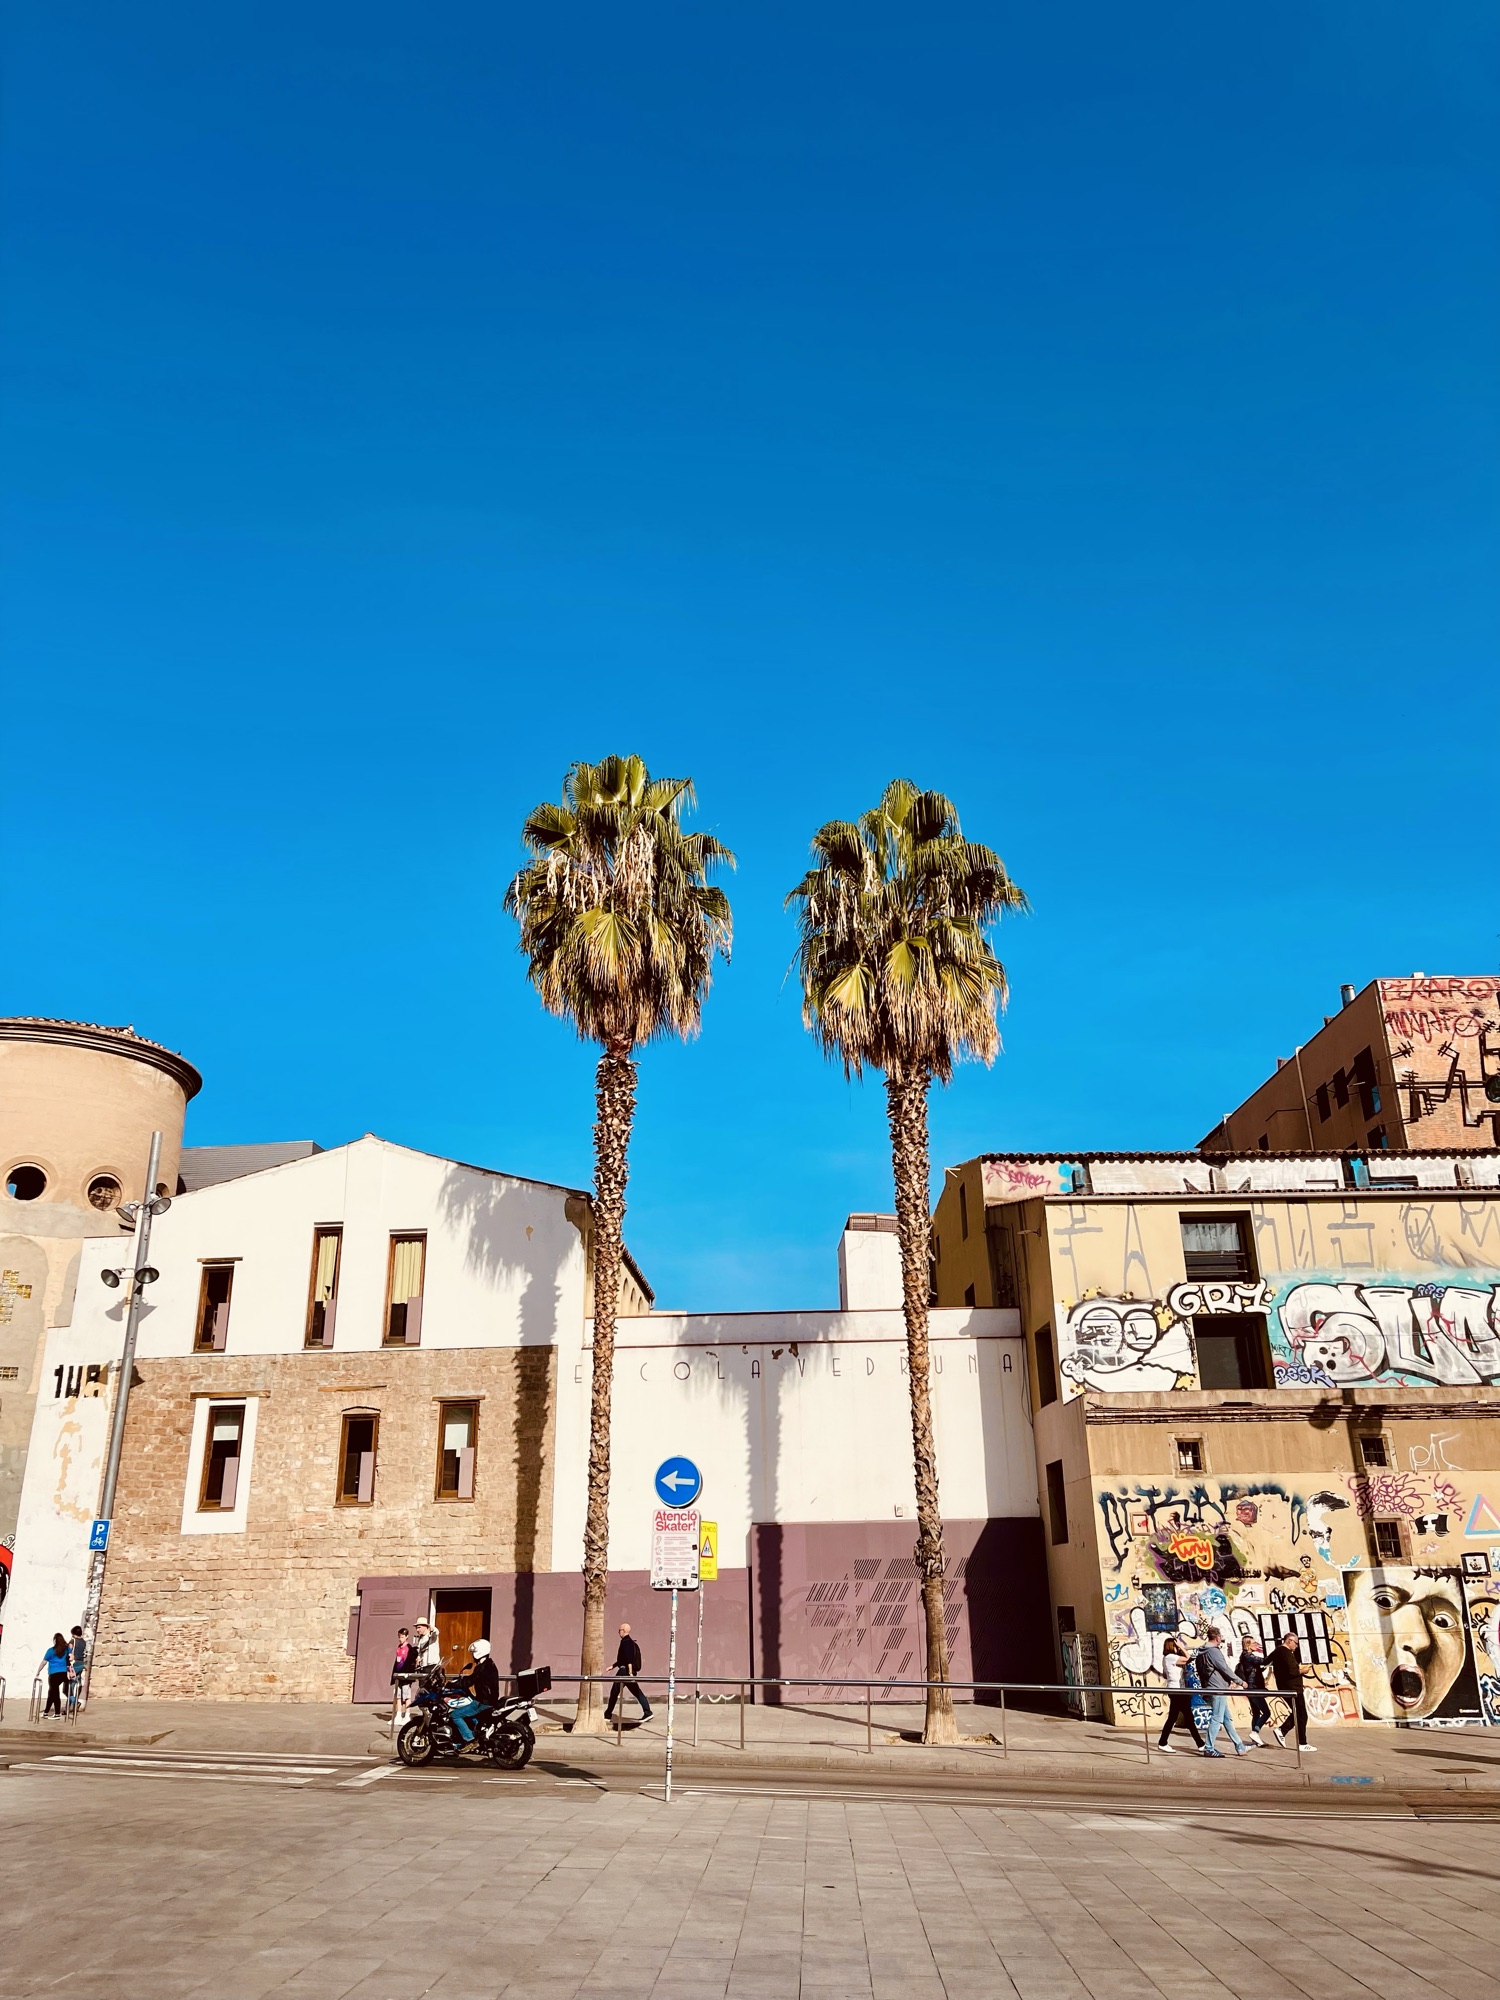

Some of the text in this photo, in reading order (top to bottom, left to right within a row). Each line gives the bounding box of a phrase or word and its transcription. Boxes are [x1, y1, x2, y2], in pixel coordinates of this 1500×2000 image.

[574, 1353, 1013, 1384] ECOLA VEDRUNA
[655, 1511, 698, 1521] Atenció
[95, 1523, 106, 1536] P
[655, 1520, 697, 1532] Skater!
[1168, 1533, 1214, 1570] tiny
